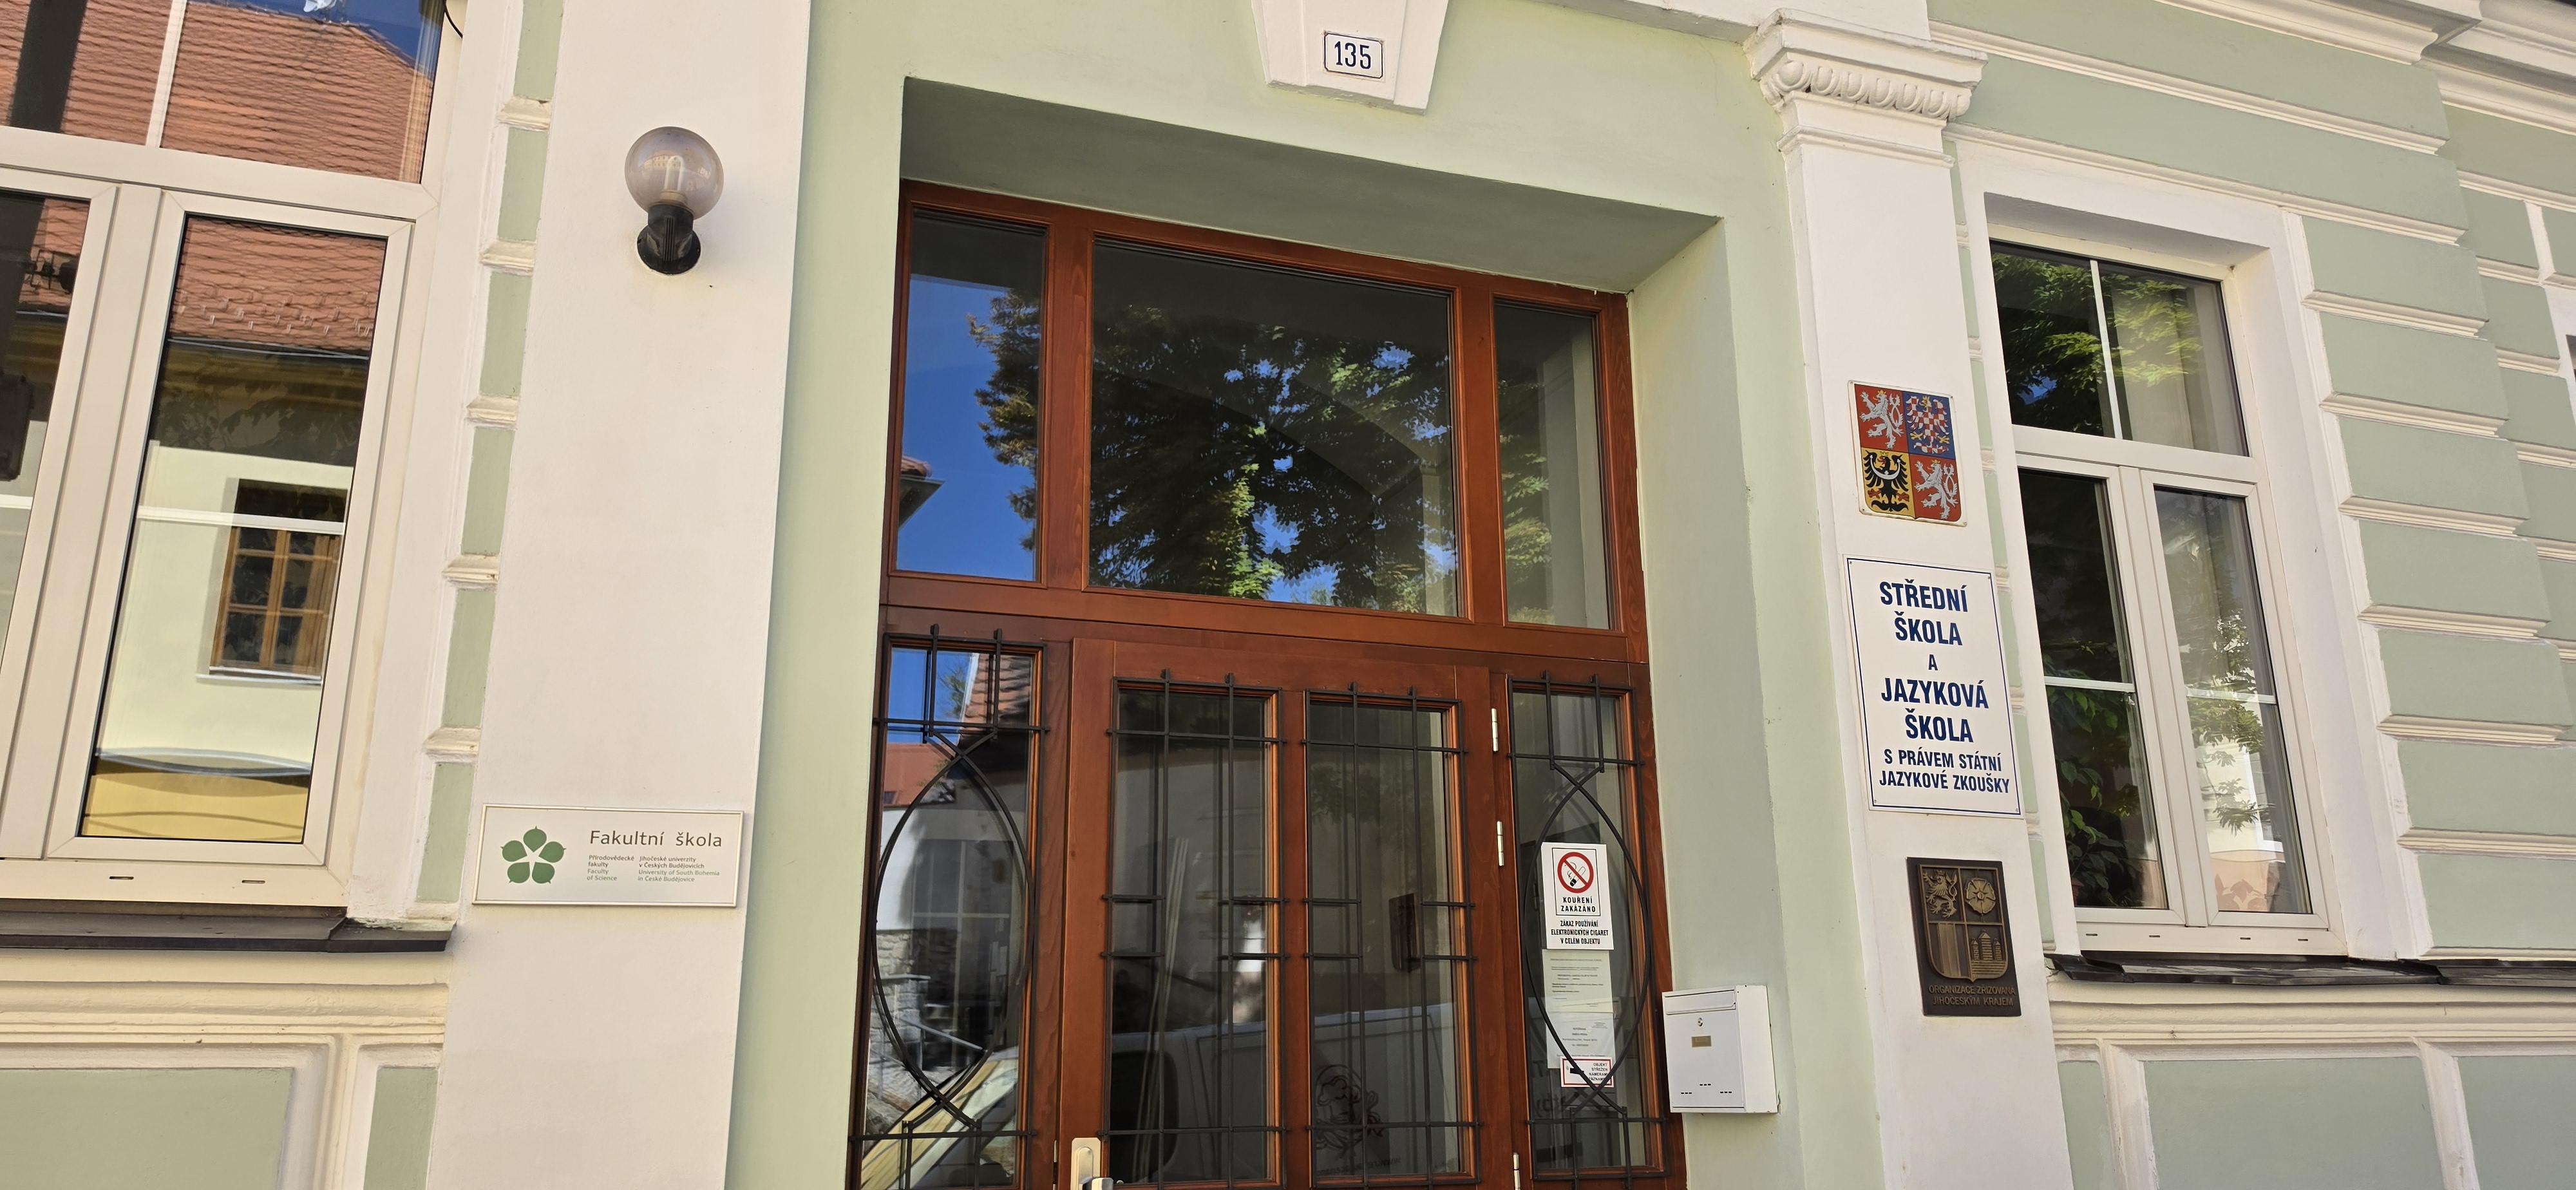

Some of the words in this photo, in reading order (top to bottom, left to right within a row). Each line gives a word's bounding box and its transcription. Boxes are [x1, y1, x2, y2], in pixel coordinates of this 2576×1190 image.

[1334, 41, 1371, 69] 135
[1879, 579, 1968, 612] STŘEDNÍ
[1895, 611, 1962, 645] ŠKOLA
[1928, 654, 1938, 671] A
[1881, 677, 1989, 708] JAZYKOVÁ
[1906, 708, 1973, 742] ŠKOLA
[1884, 748, 1893, 764] S
[1899, 748, 1954, 768] PRÁVEM
[1959, 751, 2002, 771] STÁTNÍ
[1879, 770, 1948, 789] JAZYKOVÉ
[1954, 773, 2009, 793] ZKOUŠKY
[590, 830, 664, 846] Fakultní
[676, 832, 722, 847] škola
[1561, 904, 1596, 912] ZAKÁZÁNO
[1929, 985, 1976, 994] ORGANIZACE
[1933, 995, 1980, 1005] JIHOČESKÝM
[1984, 997, 2013, 1006] KRAJEM
